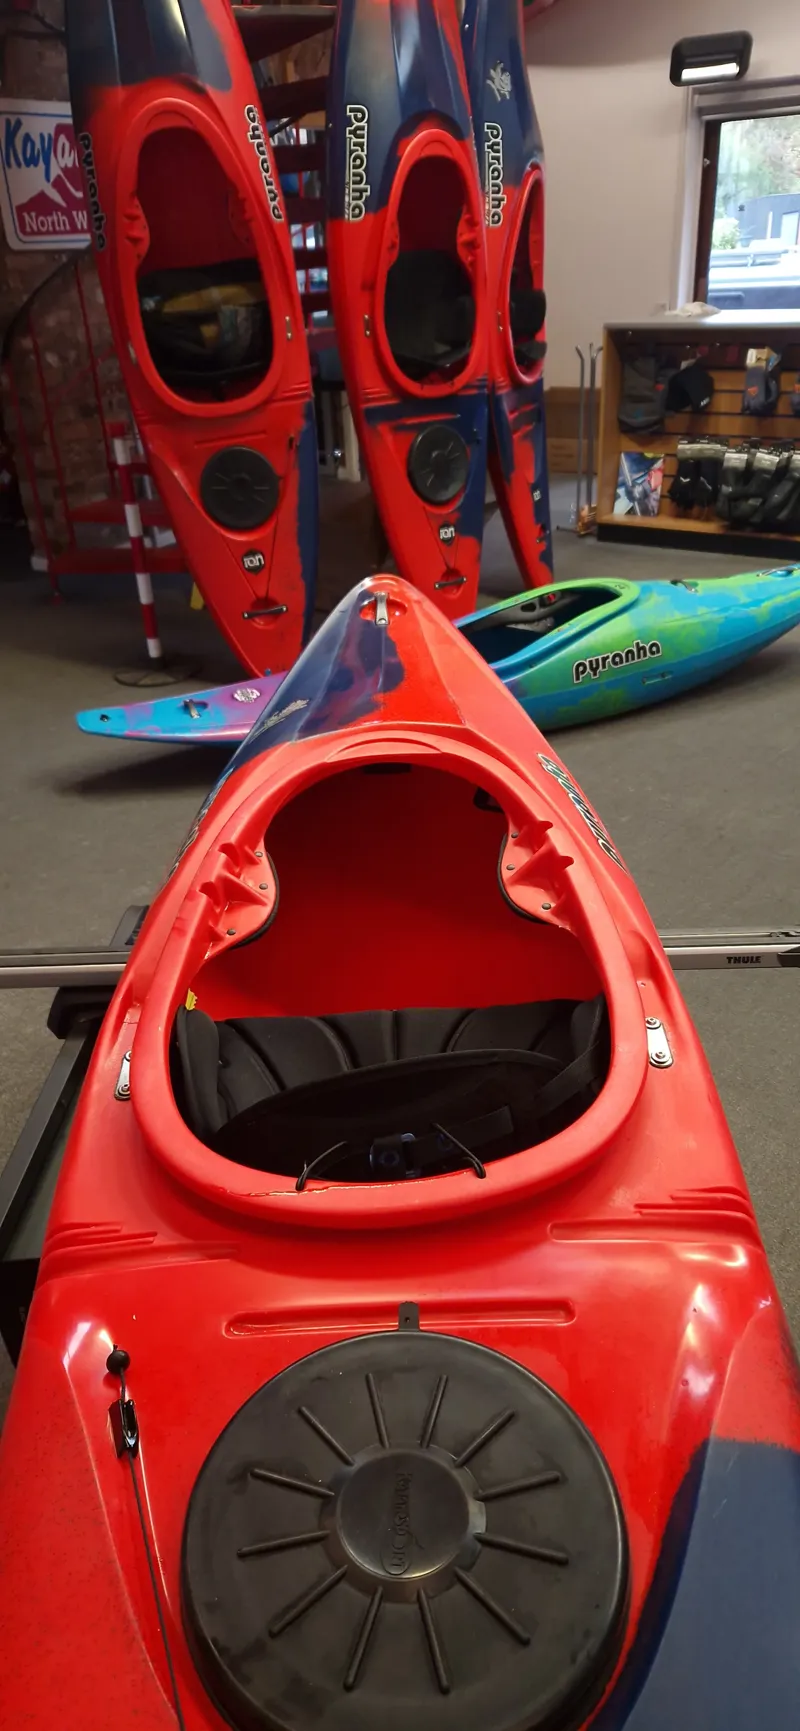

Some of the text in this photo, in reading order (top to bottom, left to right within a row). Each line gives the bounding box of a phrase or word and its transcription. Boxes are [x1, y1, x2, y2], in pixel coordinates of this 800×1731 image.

[79, 132, 106, 252] pyranha
[244, 105, 284, 221] pyranha
[347, 105, 370, 221] pyranha
[485, 122, 507, 227] pyranha
[22, 211, 70, 232] North
[573, 640, 662, 683] pyranha
[726, 956, 762, 964] THULE
